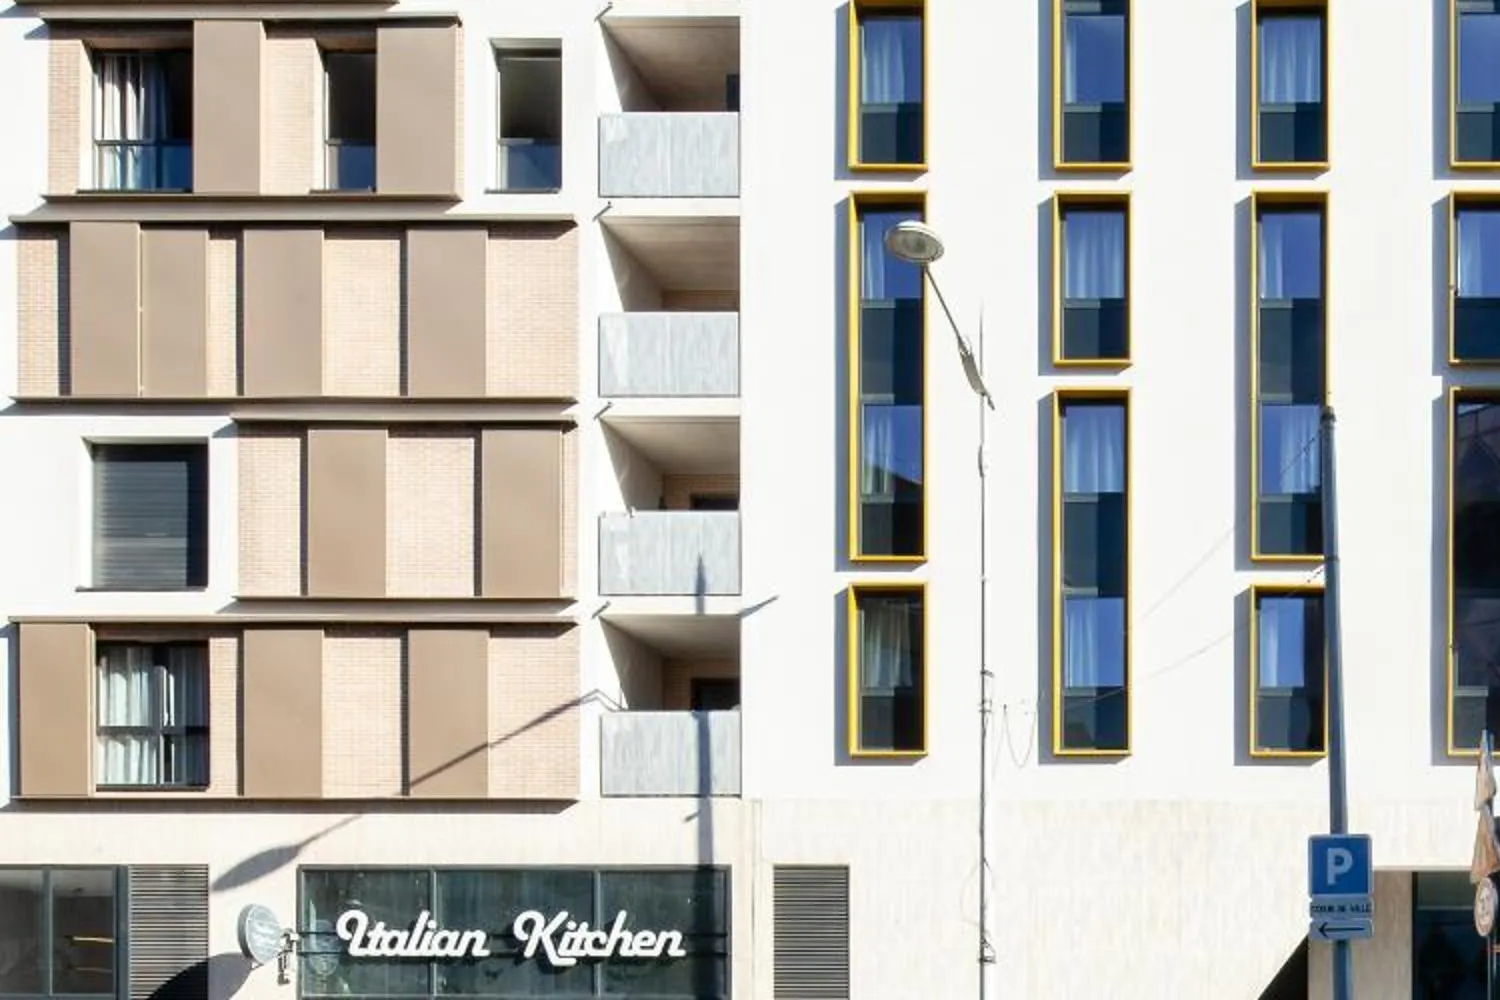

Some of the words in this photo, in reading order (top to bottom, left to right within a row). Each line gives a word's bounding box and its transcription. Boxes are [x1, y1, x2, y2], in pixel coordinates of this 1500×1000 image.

[1327, 848, 1353, 885] P
[336, 909, 490, 957] Italian
[513, 909, 685, 966] Kitchen
